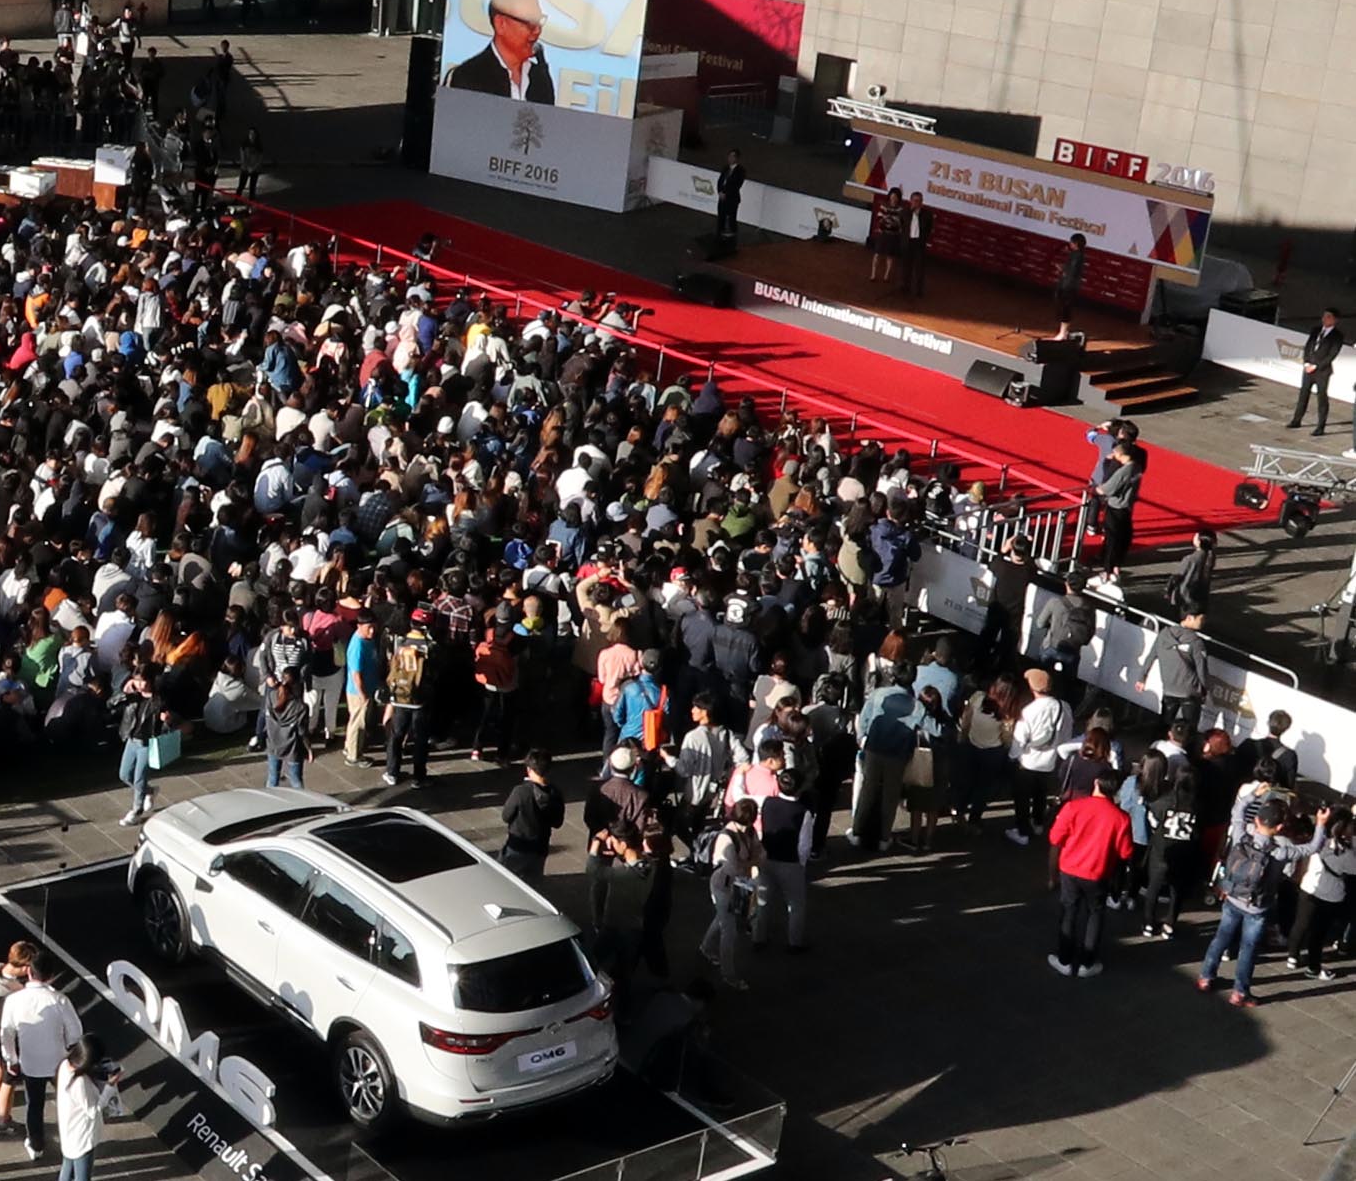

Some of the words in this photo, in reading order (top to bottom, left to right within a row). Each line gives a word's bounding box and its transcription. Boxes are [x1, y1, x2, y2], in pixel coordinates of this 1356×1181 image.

[699, 50, 744, 72] Festival
[488, 156, 522, 176] BIFF
[525, 164, 560, 184] 2016
[929, 160, 972, 186] 21st
[977, 171, 1067, 209] BUSAN
[1056, 140, 1144, 179] BIFF
[1156, 163, 1215, 193] 2016
[927, 180, 1013, 214] International
[1015, 199, 1046, 222] Film
[1046, 210, 1108, 236] Festival
[754, 281, 800, 308] BUSAN
[800, 296, 874, 331] International
[874, 317, 903, 340] Film
[902, 325, 953, 355] Festival
[106, 960, 277, 1127] QM6
[530, 1046, 566, 1064] QM6
[187, 1112, 249, 1173] Renault
